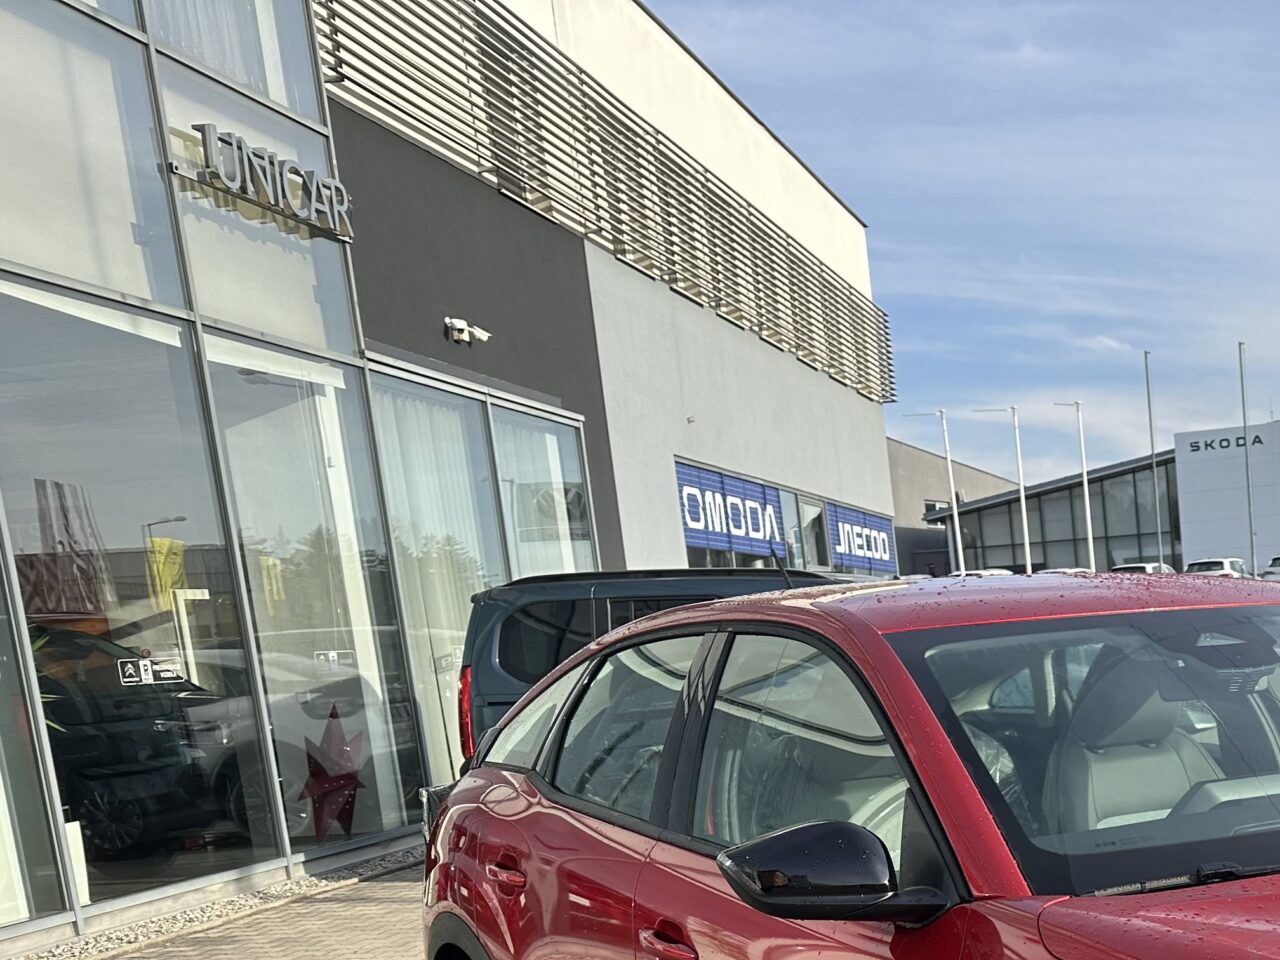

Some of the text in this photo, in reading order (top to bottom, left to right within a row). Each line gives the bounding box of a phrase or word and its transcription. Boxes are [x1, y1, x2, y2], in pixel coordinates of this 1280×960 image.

[194, 123, 354, 238] UNICAR
[1190, 434, 1264, 452] SKODA
[682, 485, 780, 542] OMODA
[835, 521, 889, 561] JAECOO
